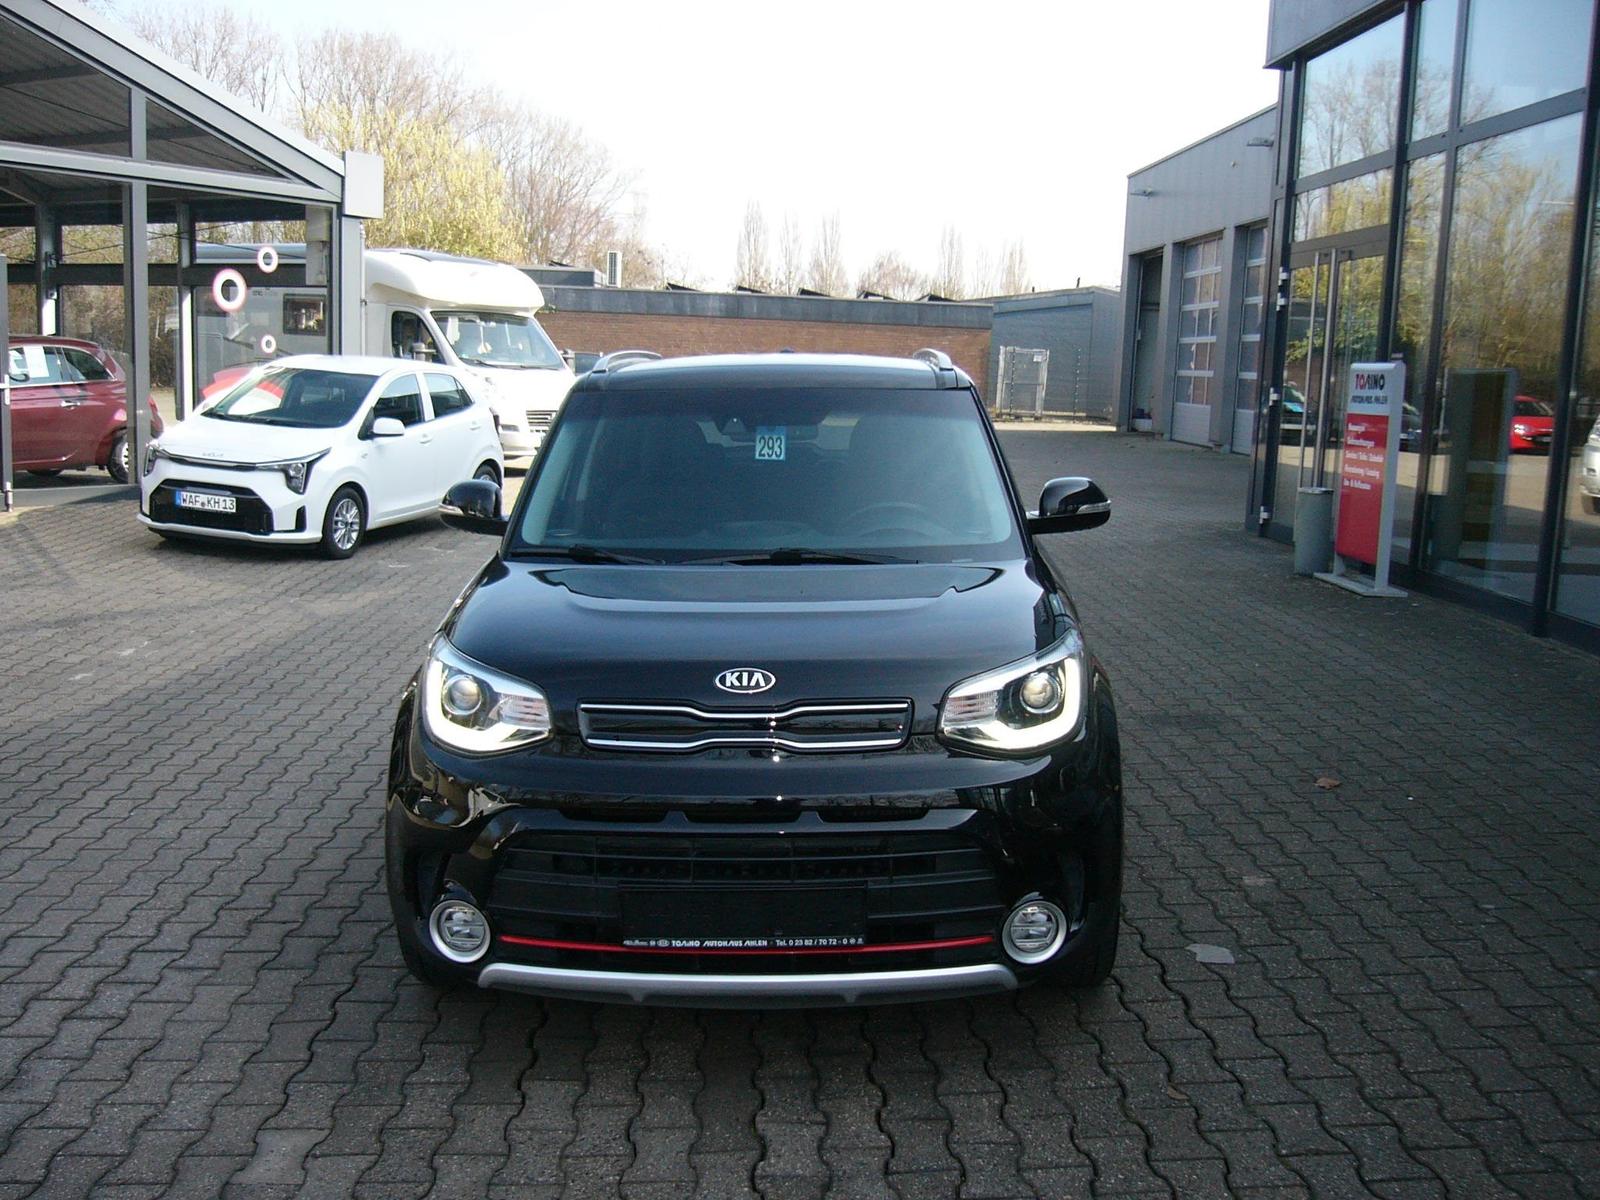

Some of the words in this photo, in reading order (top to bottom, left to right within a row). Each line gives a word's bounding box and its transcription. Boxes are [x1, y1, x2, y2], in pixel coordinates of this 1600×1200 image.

[757, 436, 783, 458] 293
[182, 493, 200, 506] WAF
[207, 497, 220, 509] KH
[222, 499, 235, 511] 13
[725, 672, 766, 687] KIA
[703, 939, 743, 947] AUTOHAUS
[743, 939, 768, 947] AHLEN
[819, 938, 828, 946] 70
[828, 938, 837, 946] 72
